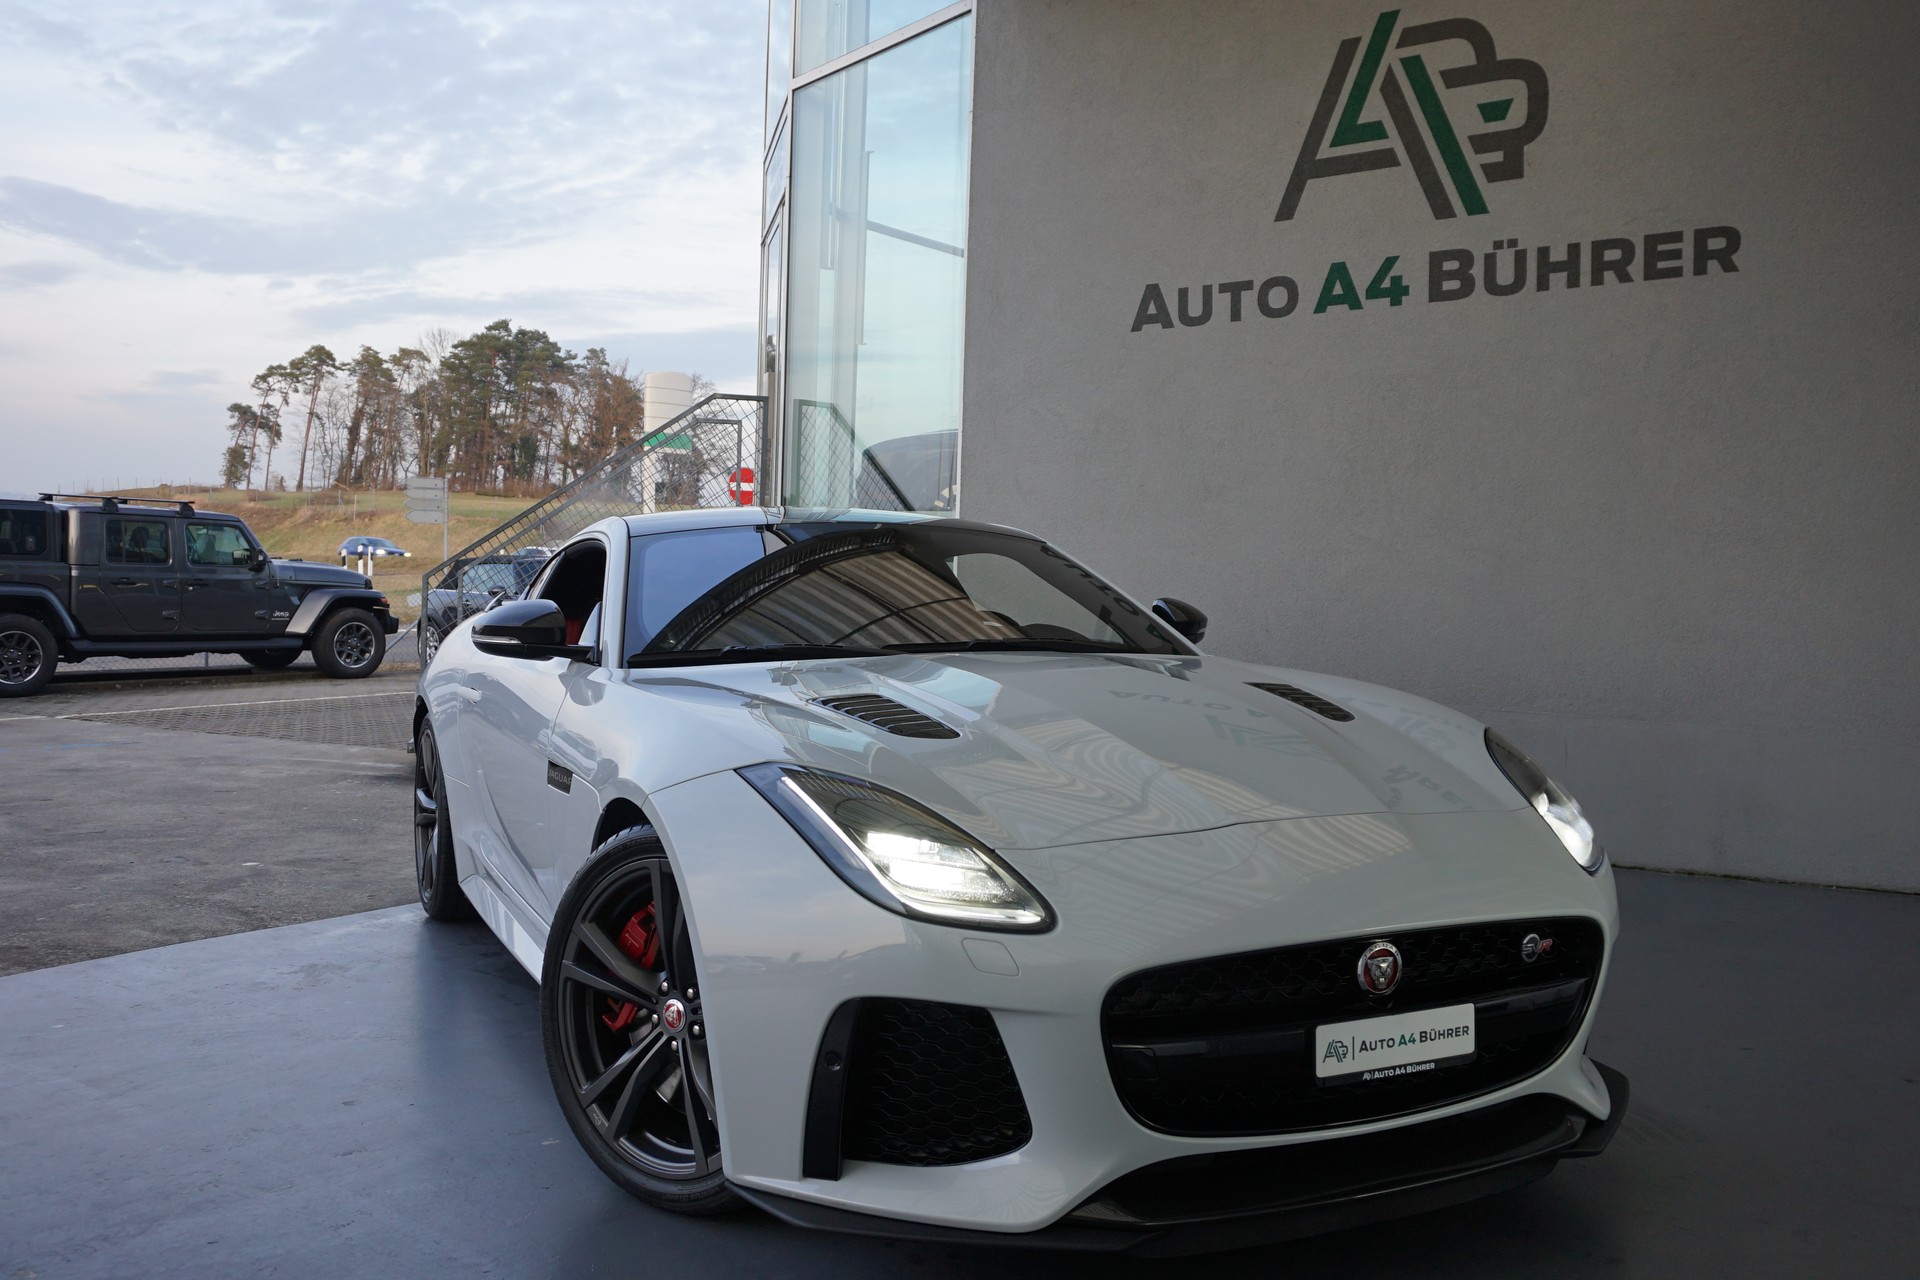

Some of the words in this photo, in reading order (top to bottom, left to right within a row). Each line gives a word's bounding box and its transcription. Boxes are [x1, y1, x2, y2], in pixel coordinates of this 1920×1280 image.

[1131, 275, 1299, 332] AUTO
[1313, 255, 1410, 314] A4
[1427, 225, 1742, 302] BÜHRER
[272, 609, 290, 618] Jeep
[1358, 1037, 1395, 1053] AUTO
[1398, 1032, 1417, 1047] A4
[1419, 1025, 1469, 1043] BÜHRER
[1373, 1069, 1394, 1079] AUTO
[1395, 1067, 1406, 1076] A4
[1406, 1062, 1436, 1074] BÜHRER
